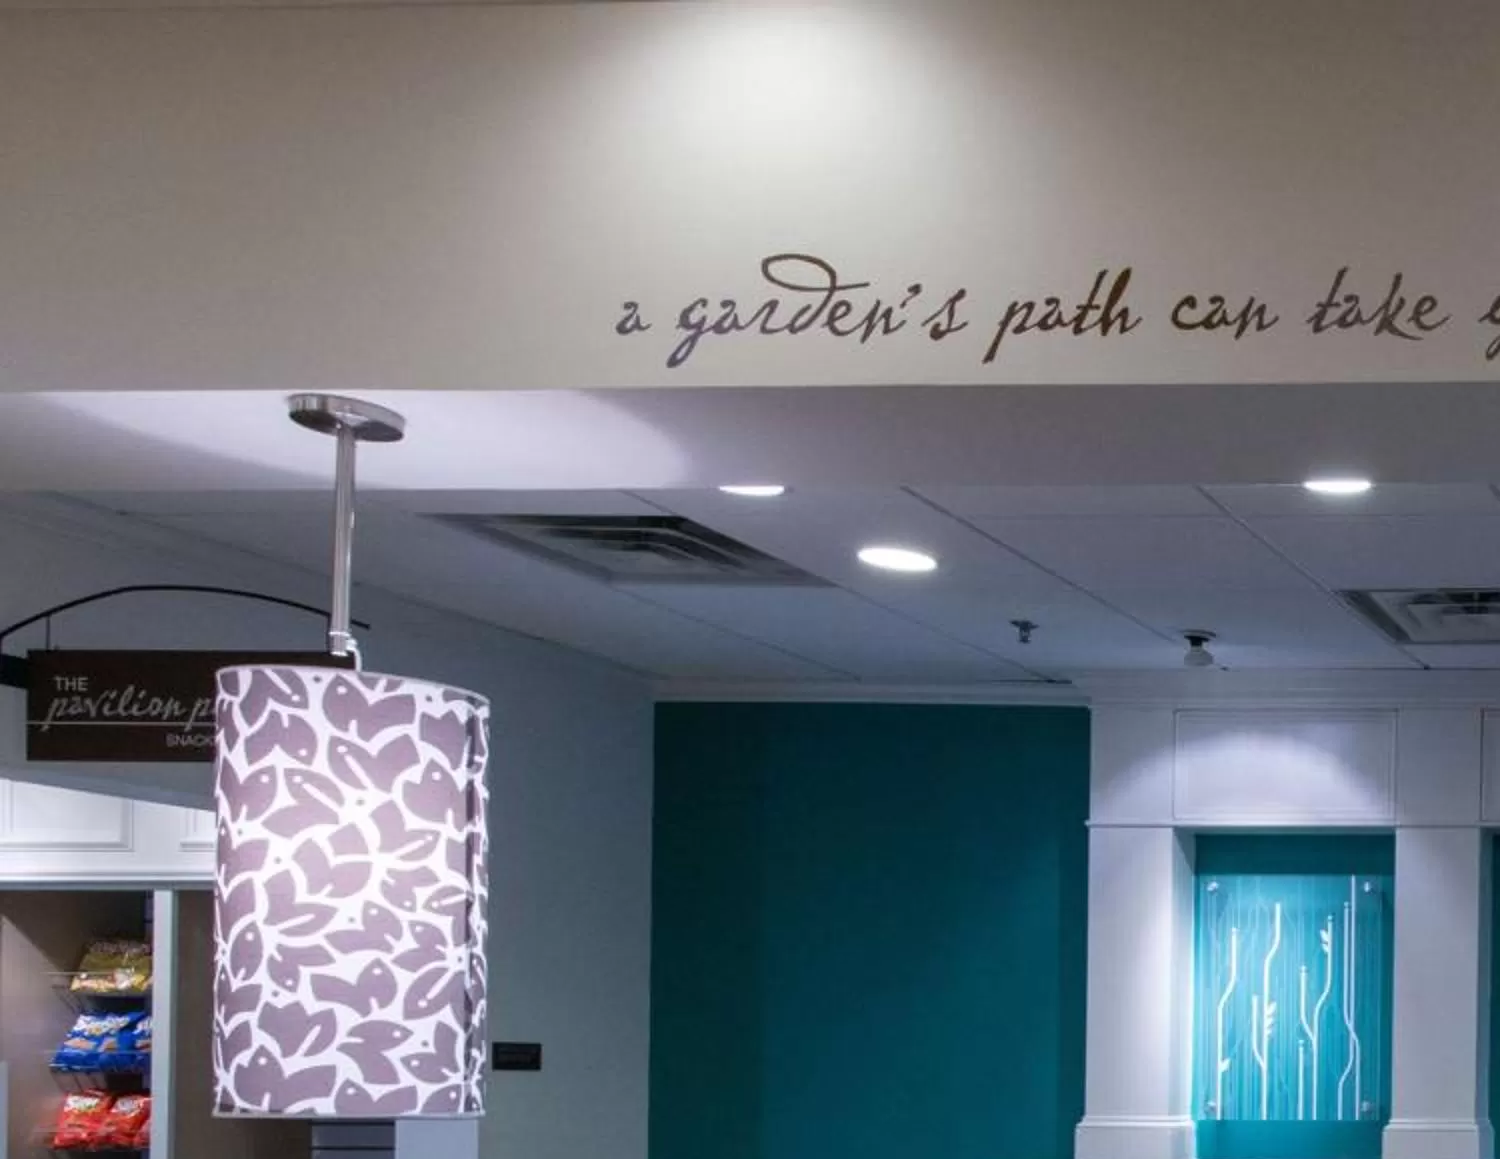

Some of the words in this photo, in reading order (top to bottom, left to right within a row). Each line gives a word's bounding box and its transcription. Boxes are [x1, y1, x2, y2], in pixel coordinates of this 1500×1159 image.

[615, 301, 652, 336] a
[666, 253, 969, 368] garden's
[982, 267, 1143, 364] path
[1170, 295, 1279, 341] can
[1306, 266, 1450, 341] take
[54, 675, 89, 692] THE
[40, 685, 188, 732] pavilion
